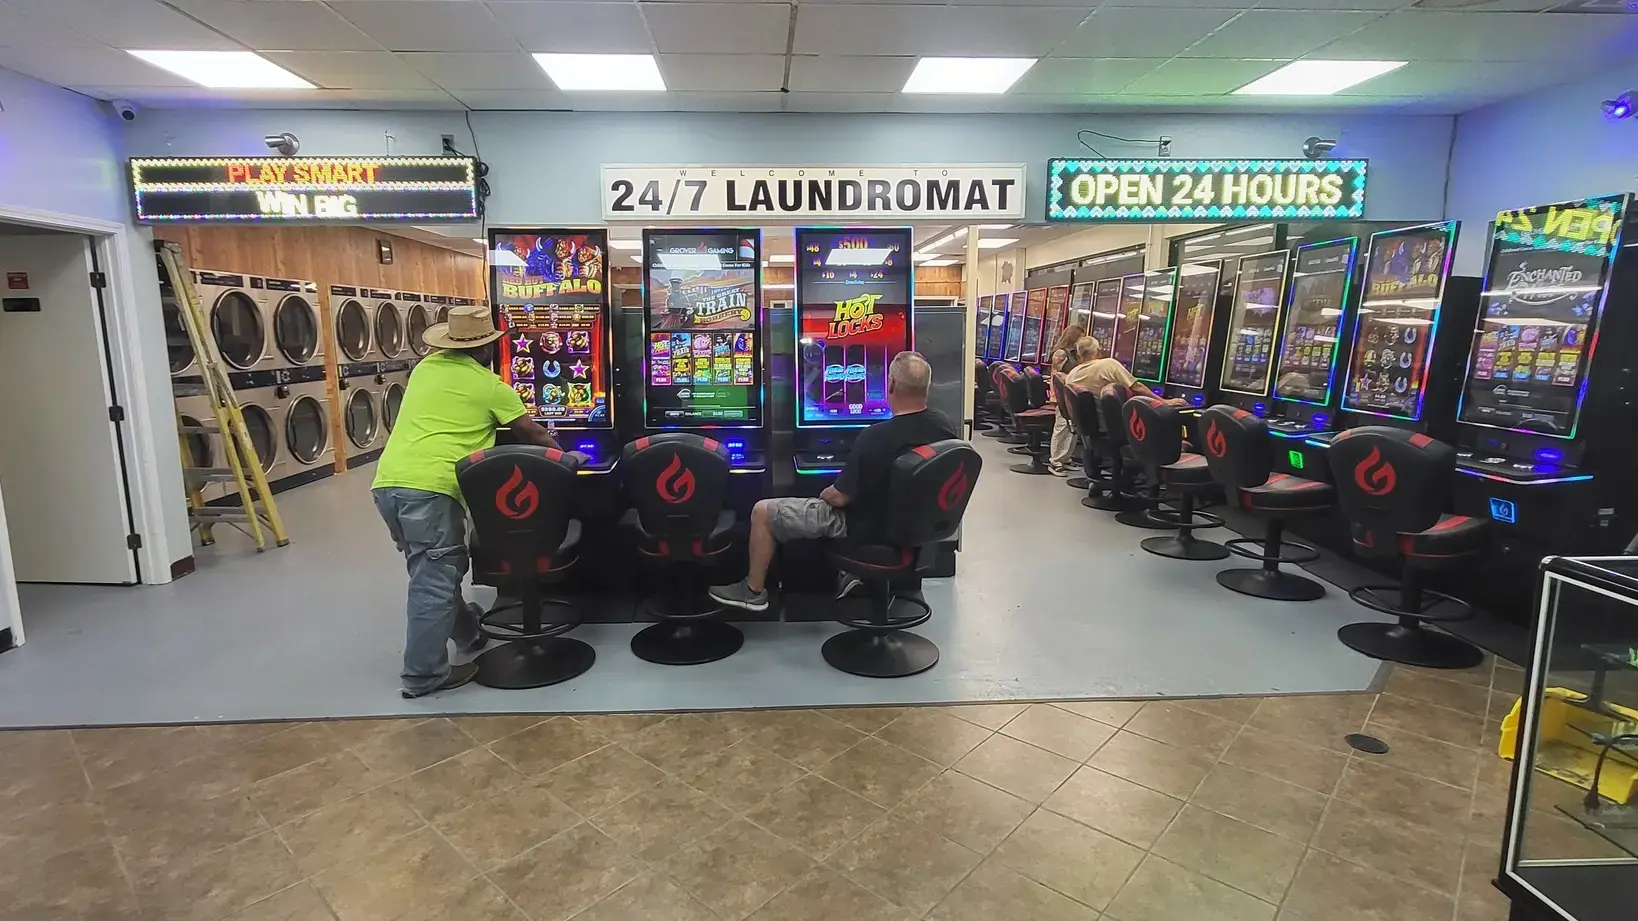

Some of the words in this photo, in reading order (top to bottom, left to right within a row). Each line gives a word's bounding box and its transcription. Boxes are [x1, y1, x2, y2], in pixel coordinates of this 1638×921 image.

[227, 163, 288, 183] PLAY
[293, 163, 379, 184] SMART
[680, 169, 865, 177] WELCOME
[912, 169, 948, 177] TO
[611, 179, 706, 215] 24/7
[726, 179, 1015, 211] LAUNDROMAT
[1070, 174, 1164, 205] OPEN
[1170, 174, 1214, 204] 24
[1222, 174, 1344, 204] HOURS
[255, 190, 308, 216] WIN
[314, 194, 358, 218] BIG
[502, 278, 602, 299] BUFFALO
[696, 292, 747, 316] TRAIN
[834, 294, 883, 322] HOT
[827, 314, 884, 339] LOCKS
